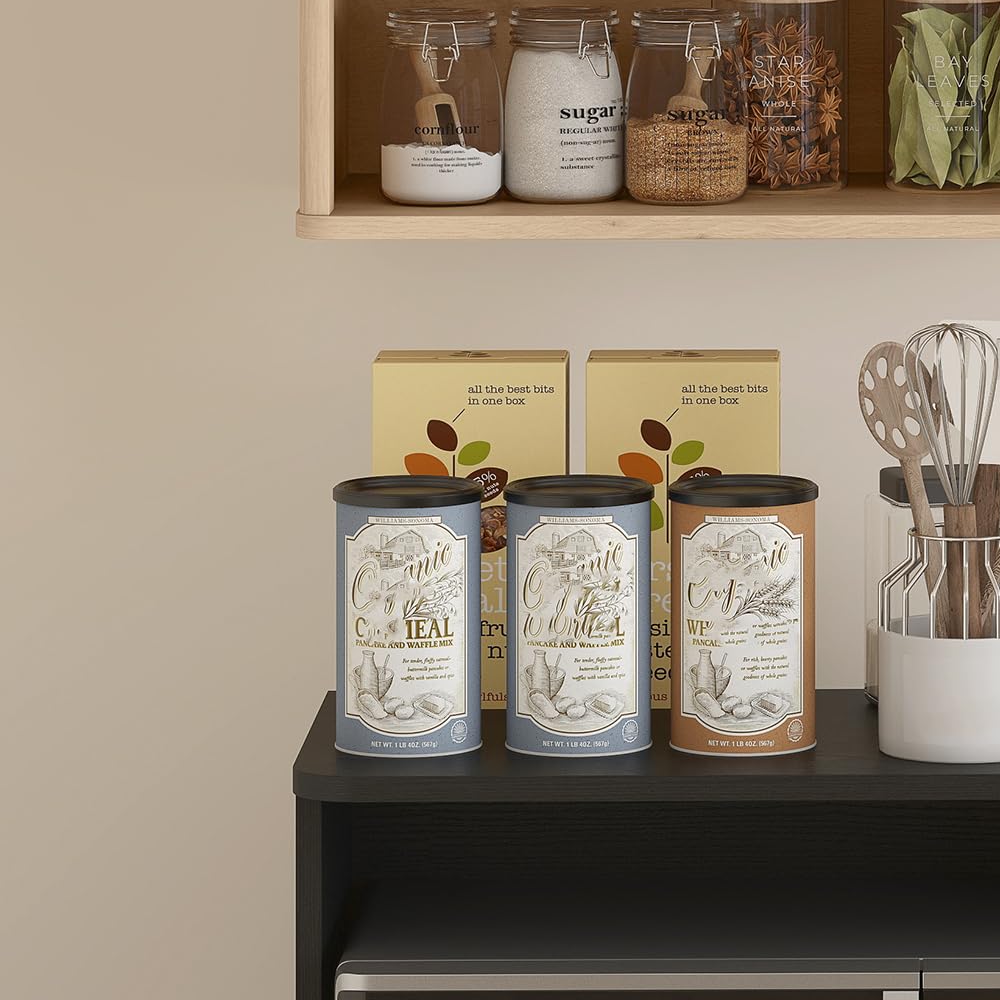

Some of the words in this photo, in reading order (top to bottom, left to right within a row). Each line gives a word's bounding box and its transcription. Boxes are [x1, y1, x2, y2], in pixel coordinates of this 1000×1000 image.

[754, 55, 804, 69] STAR
[935, 55, 974, 69] BAY
[749, 74, 810, 88] ANISE
[916, 74, 990, 88] LEAVES
[560, 105, 616, 124] sugar
[414, 124, 480, 135] cornflour
[468, 384, 482, 393] all
[485, 384, 504, 393] the
[507, 384, 531, 393] best
[533, 384, 555, 393] bits
[681, 384, 696, 393] all
[699, 384, 718, 393] the
[721, 384, 744, 393] best
[747, 384, 768, 393] bits
[468, 396, 480, 405] in
[505, 396, 525, 405] box
[681, 396, 694, 405] in
[719, 396, 739, 405] box
[388, 640, 405, 649] AND
[406, 640, 439, 648] WAFFLE
[610, 638, 625, 647] MIX
